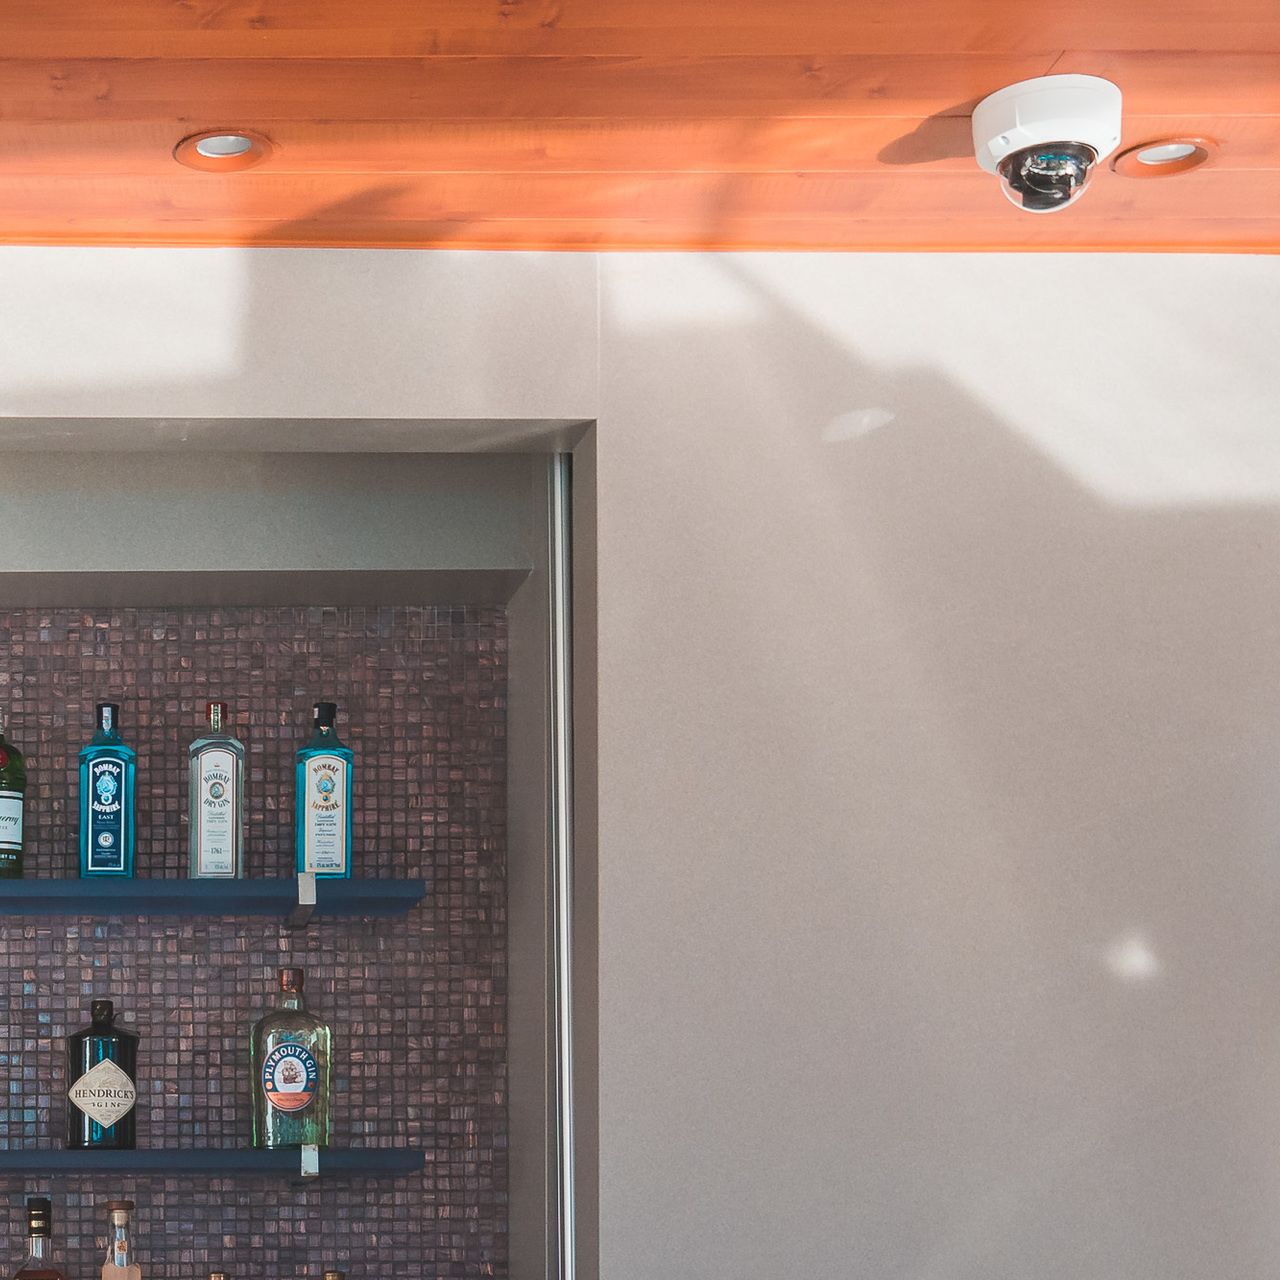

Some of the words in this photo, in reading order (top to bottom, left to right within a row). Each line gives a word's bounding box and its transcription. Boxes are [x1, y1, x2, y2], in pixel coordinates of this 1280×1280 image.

[93, 763, 121, 777] BOMBAY
[312, 763, 340, 776] BOMBAY
[202, 772, 232, 785] BOMBAY
[91, 800, 121, 813] SAPPHIRE
[203, 797, 217, 809] DRY
[217, 797, 231, 808] GIN
[311, 800, 341, 812] SAPPHIRE
[264, 1046, 308, 1080] PLYMOUTH
[306, 1060, 316, 1079] GIN
[74, 1089, 134, 1100] HENDRICK'S
